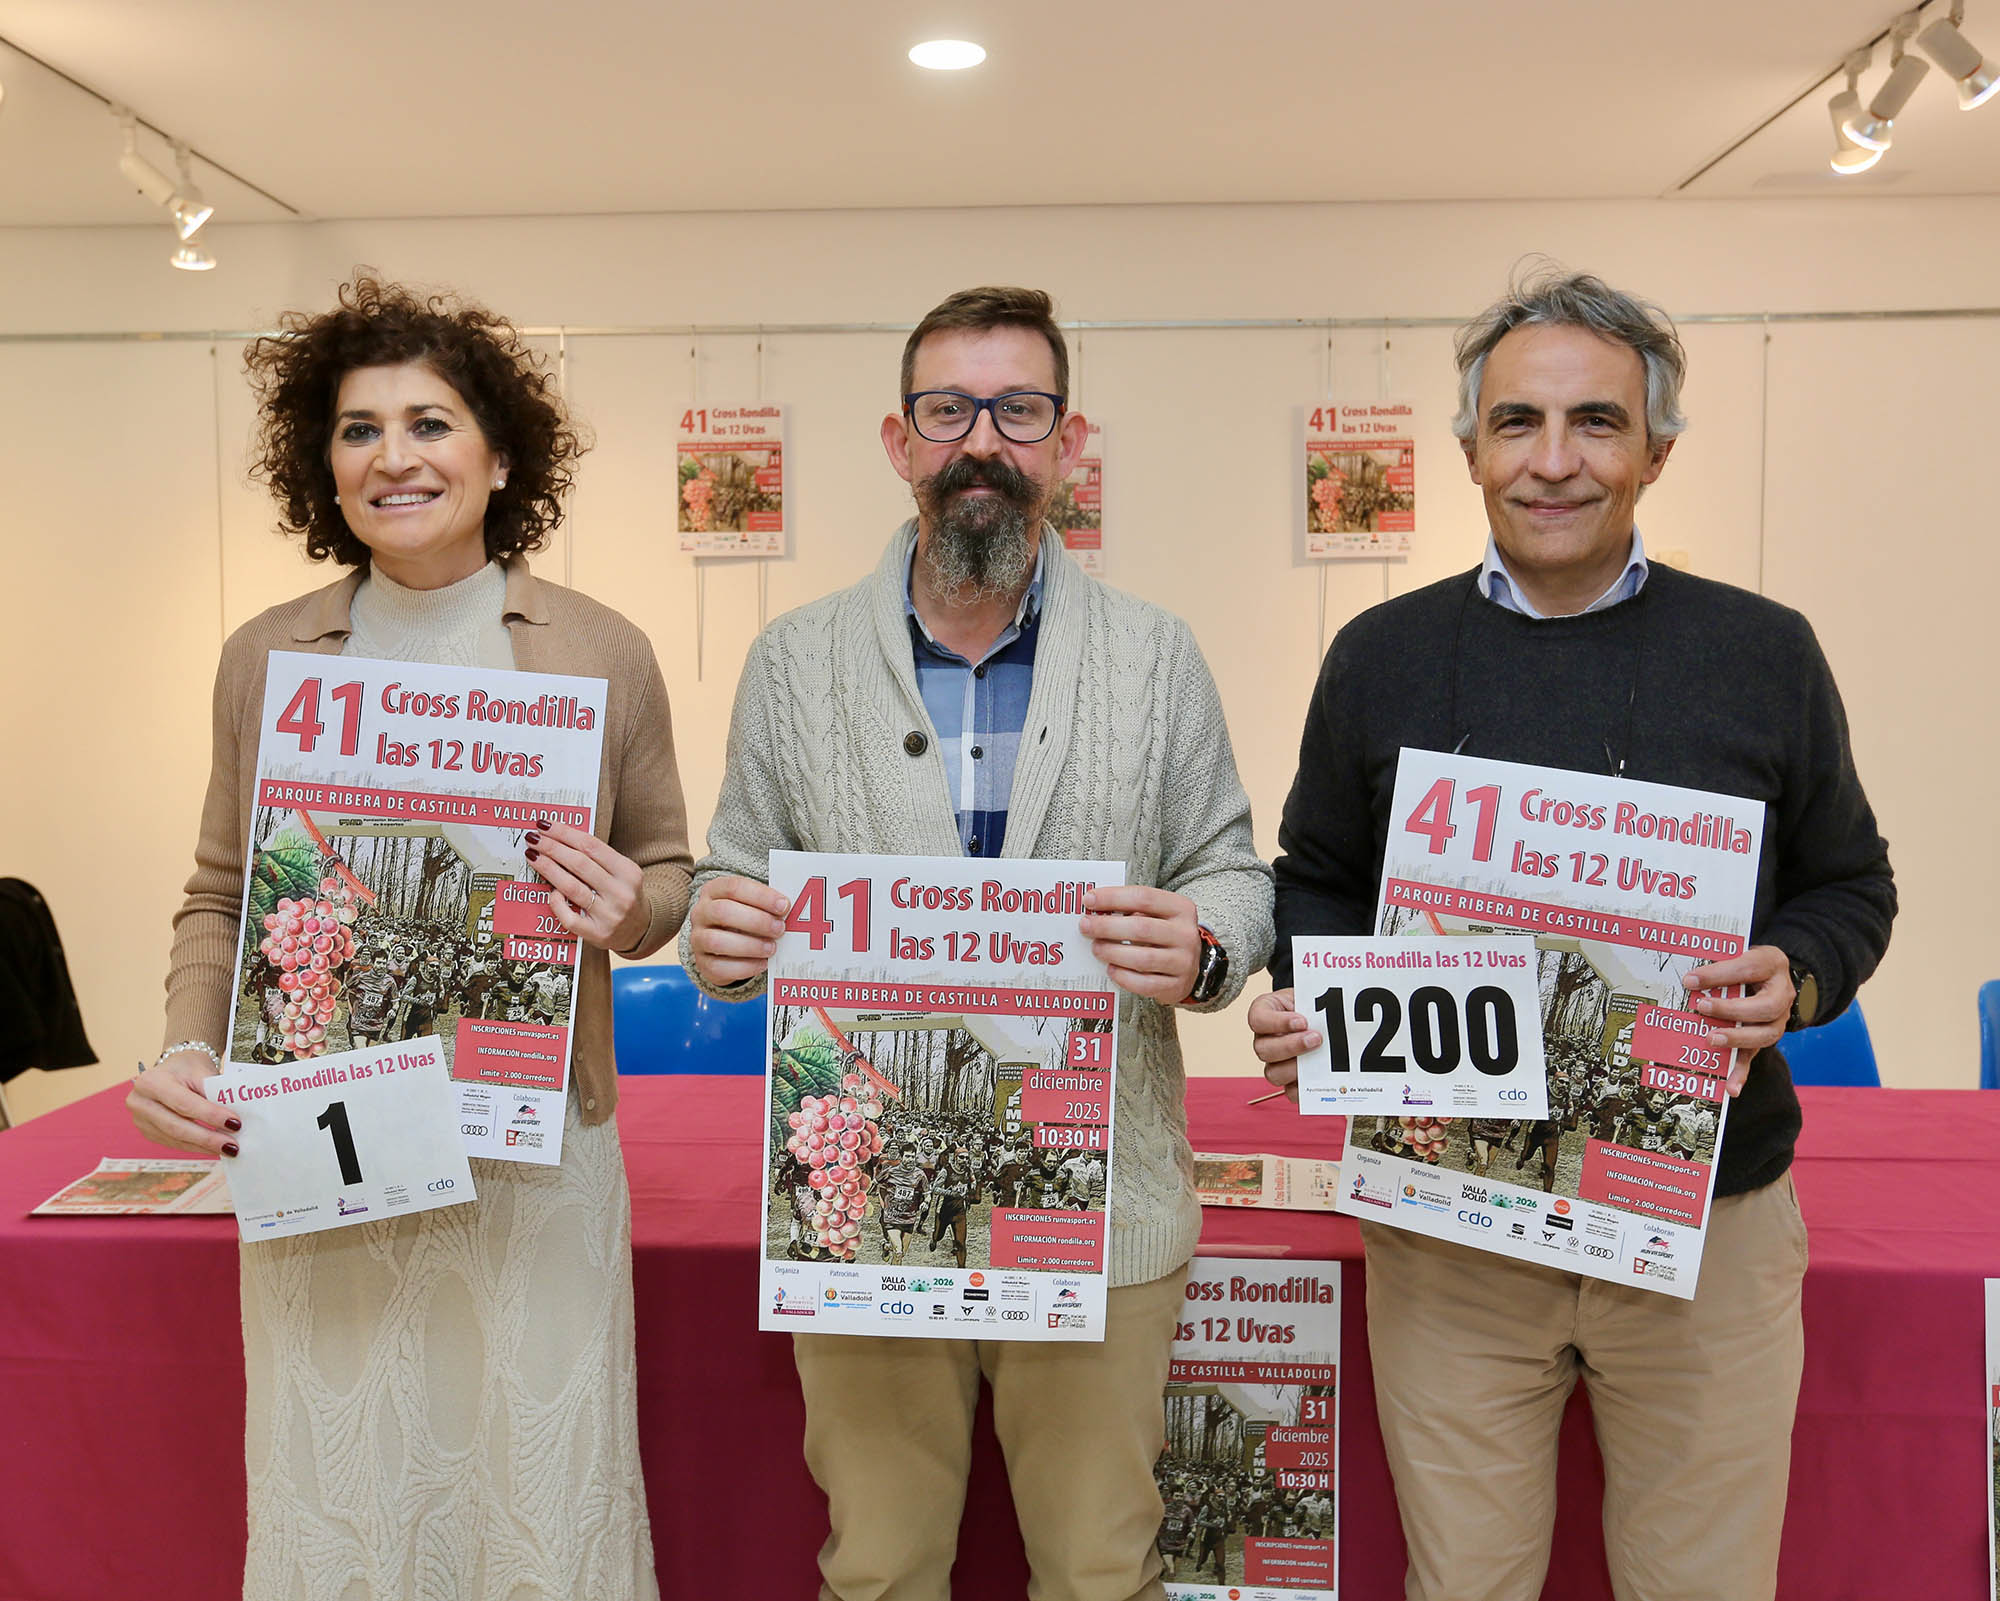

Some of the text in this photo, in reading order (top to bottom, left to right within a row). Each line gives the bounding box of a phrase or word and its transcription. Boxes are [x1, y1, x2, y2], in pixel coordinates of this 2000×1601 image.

[680, 409, 707, 433] 41
[730, 425, 740, 434] 12
[1308, 408, 1336, 432] 41
[1360, 424, 1370, 432] 12
[382, 682, 596, 730] Cross Rondilla
[276, 677, 364, 756] 41
[376, 732, 544, 777] las 12 Uvas
[266, 786, 584, 826] PARQUE RIBERA DE CASTILLA VALLADOLID
[1404, 778, 1502, 862] 41
[1520, 788, 1752, 854] Cross Rondilla
[1511, 840, 1698, 900] las 12 Uvas
[504, 884, 573, 906] diciem
[890, 876, 1108, 914] Cross Rondil
[785, 876, 872, 952] 41
[1393, 885, 1452, 907] PARQUE
[1458, 896, 1515, 918] RIBERA
[1520, 907, 1540, 922] DE
[1546, 912, 1620, 936] CASTILLA
[1639, 926, 1738, 956] VALLADOLID
[508, 940, 568, 962] 10:30 H
[890, 928, 1064, 965] las 12 Uvas
[1302, 950, 1528, 968] 41 Cross Rondilla las 12 Uvas
[781, 984, 1108, 1012] PARQUE RIBERA DE CASTILLA VALLADOLID
[471, 1024, 560, 1040] INSCRIPCIONES runvasport.es
[1314, 985, 1519, 1076] 1200
[1644, 1008, 1717, 1038] diciemb
[520, 1051, 557, 1063] rondilla.org
[1074, 1037, 1100, 1062] 31
[1679, 1046, 1721, 1070] 2025
[218, 1052, 436, 1104] 41 Cross Rondilla las 12 Uvas
[504, 1072, 522, 1080] 2.000
[522, 1073, 555, 1082] corredores
[1030, 1072, 1102, 1092] diciembre
[1648, 1068, 1716, 1098] 10:30 H
[514, 1094, 540, 1102] Colaboran
[1498, 1088, 1528, 1101] cdo
[1064, 1102, 1100, 1120] 2025
[316, 1101, 363, 1186] 1
[1038, 1128, 1100, 1148] 10:30 H
[1356, 1154, 1382, 1165] Organiza
[1600, 1147, 1700, 1177] INSCRIPCIONES runvasport.es
[1411, 1167, 1440, 1180] Patrocinan
[427, 1178, 454, 1192] cdo
[1462, 1184, 1488, 1196] VALLA
[1606, 1170, 1696, 1200] INFORMACIÓN rondilla.org
[1418, 1194, 1452, 1206] Valladolid
[1462, 1192, 1488, 1204] DOLID
[1516, 1196, 1538, 1208] 2026
[1635, 1198, 1654, 1211] 2.000
[1656, 1204, 1693, 1220] corredores
[1006, 1213, 1096, 1225] INSCRIPCIONES runvasport.es
[1458, 1210, 1493, 1228] cdo
[1644, 1223, 1674, 1238] Colaboran
[1058, 1237, 1095, 1247] rondilla.org
[774, 1266, 800, 1275] Organiza
[830, 1270, 860, 1278] Patrocinan
[882, 1276, 906, 1284] VALLA
[882, 1284, 906, 1292] DOLID
[933, 1278, 954, 1286] 2026
[1052, 1278, 1080, 1287] Colaboran
[1185, 1276, 1334, 1304] oss Rondilla
[880, 1300, 914, 1315] cdo
[1173, 1318, 1296, 1344] as 12 Uvas
[1172, 1365, 1331, 1380] DE CASTILLA VALLADOLID
[1304, 1400, 1327, 1420] 31
[1271, 1428, 1329, 1444] diciembre
[1300, 1452, 1329, 1467] 2025
[1280, 1472, 1328, 1488] 10:30 H
